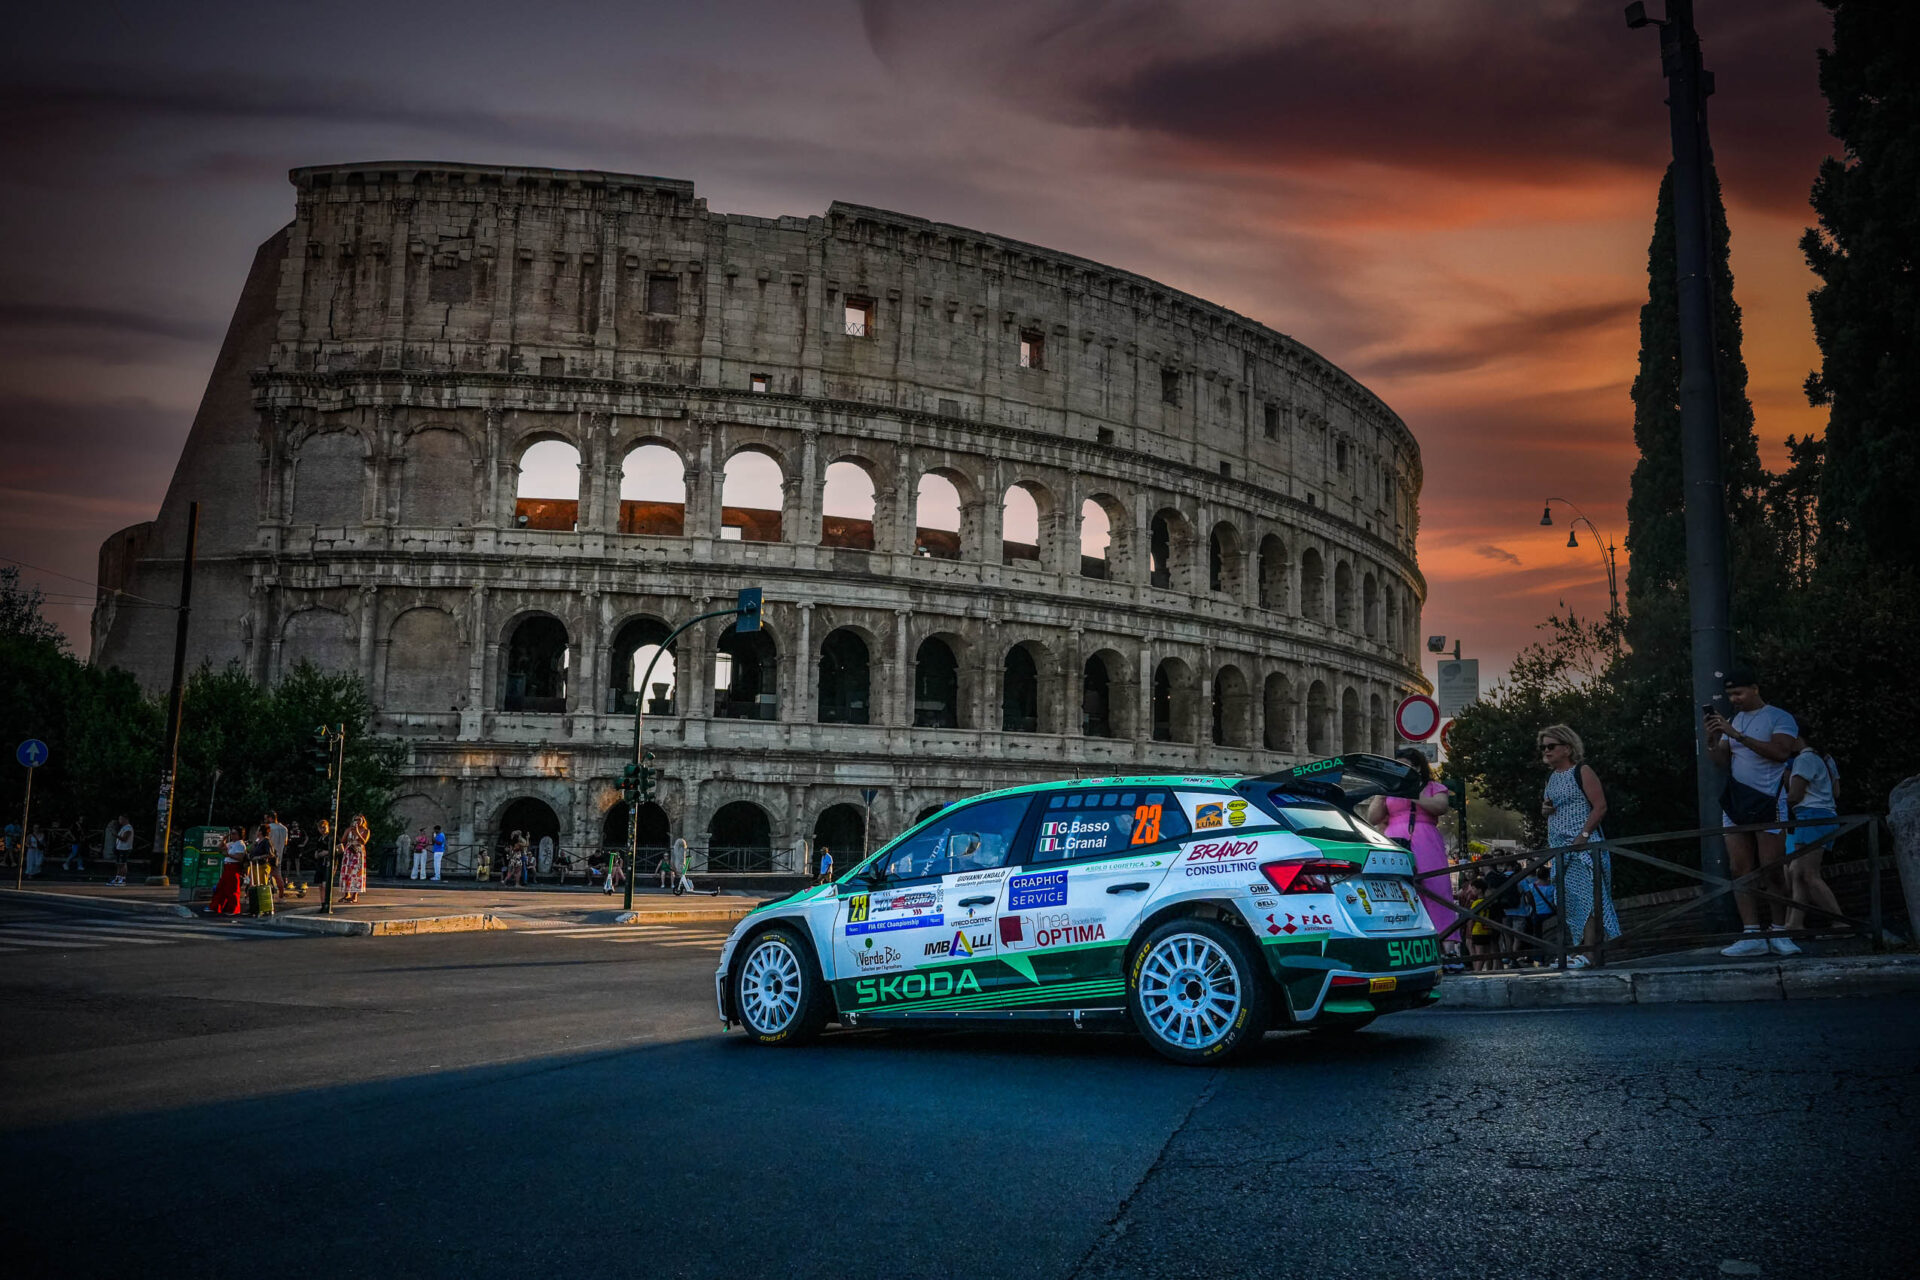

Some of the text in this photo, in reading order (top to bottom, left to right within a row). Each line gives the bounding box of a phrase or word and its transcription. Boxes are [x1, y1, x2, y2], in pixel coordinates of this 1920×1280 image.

[1057, 821, 1110, 834] G.Basso
[1131, 804, 1162, 845] 23
[1196, 820, 1222, 828] LUMA
[1054, 836, 1107, 850] L.Granai
[1187, 840, 1259, 861] BRANDO
[1185, 861, 1257, 876] CONSULTING
[957, 873, 983, 882] GIOVANNI
[1012, 874, 1064, 889] GRAPHIC
[1249, 885, 1270, 894] OMP
[1012, 891, 1064, 906] SERVICE
[851, 895, 867, 922] 23
[887, 919, 919, 928] Championship
[951, 918, 969, 927] UTECO
[1036, 912, 1070, 929] linea
[1301, 914, 1333, 925] FAG
[1036, 923, 1106, 947] OPTIMA
[857, 946, 902, 966] Verde Bio
